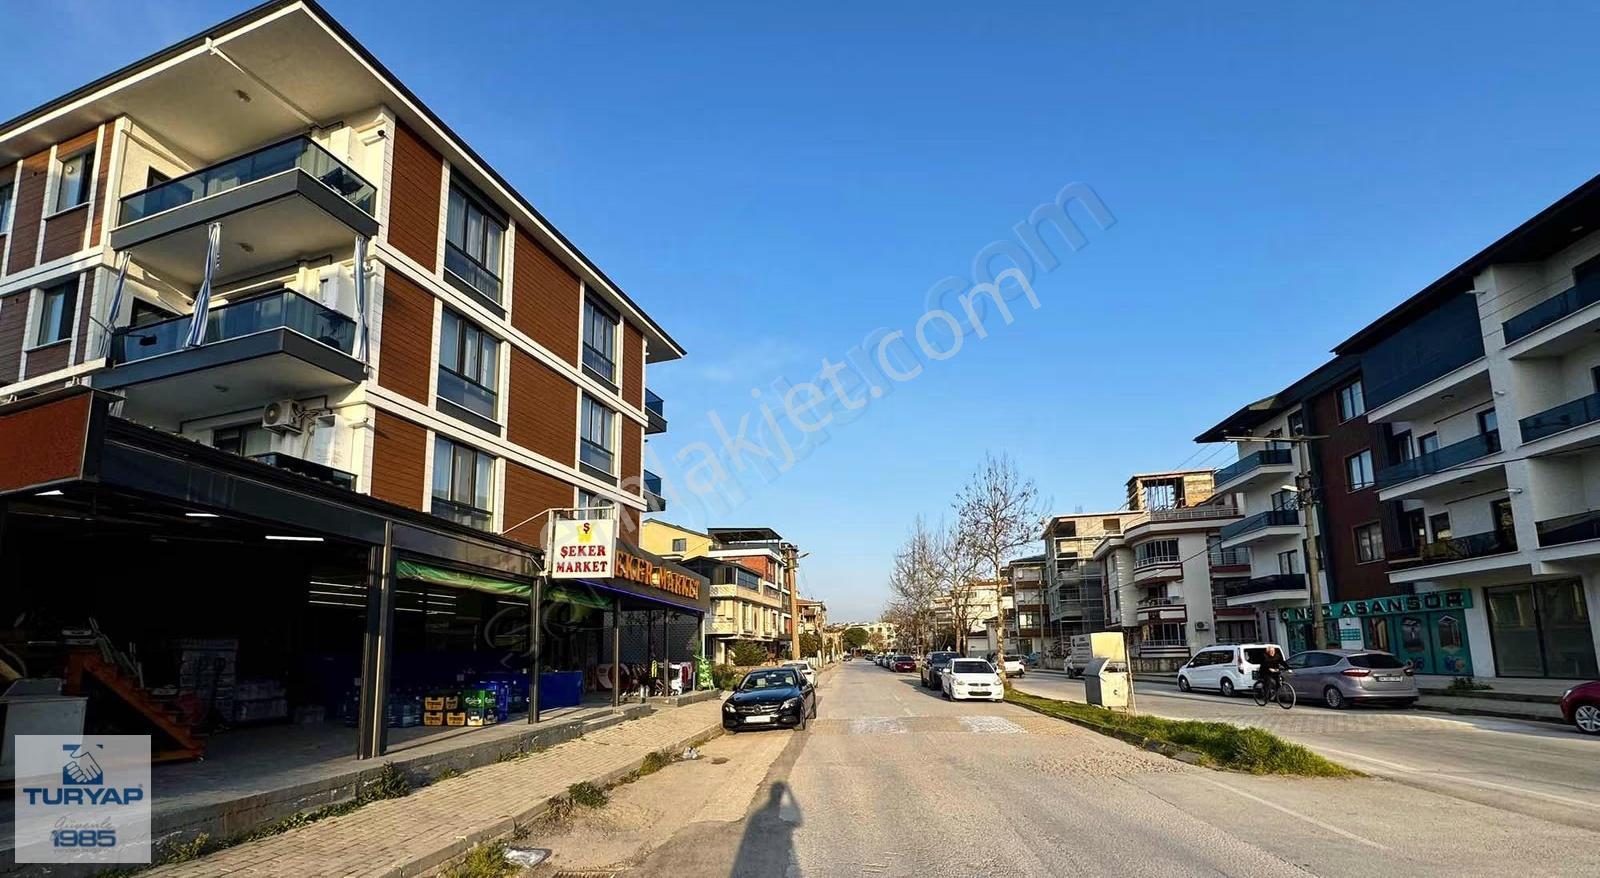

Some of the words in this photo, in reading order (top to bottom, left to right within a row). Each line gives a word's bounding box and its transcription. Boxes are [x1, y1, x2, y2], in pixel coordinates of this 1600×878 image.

[560, 545, 606, 558] ŞEKER
[556, 561, 608, 573] MARKET
[615, 550, 653, 585] EKER
[659, 566, 701, 599] MARKET
[1341, 591, 1464, 616] ASANSÖR
